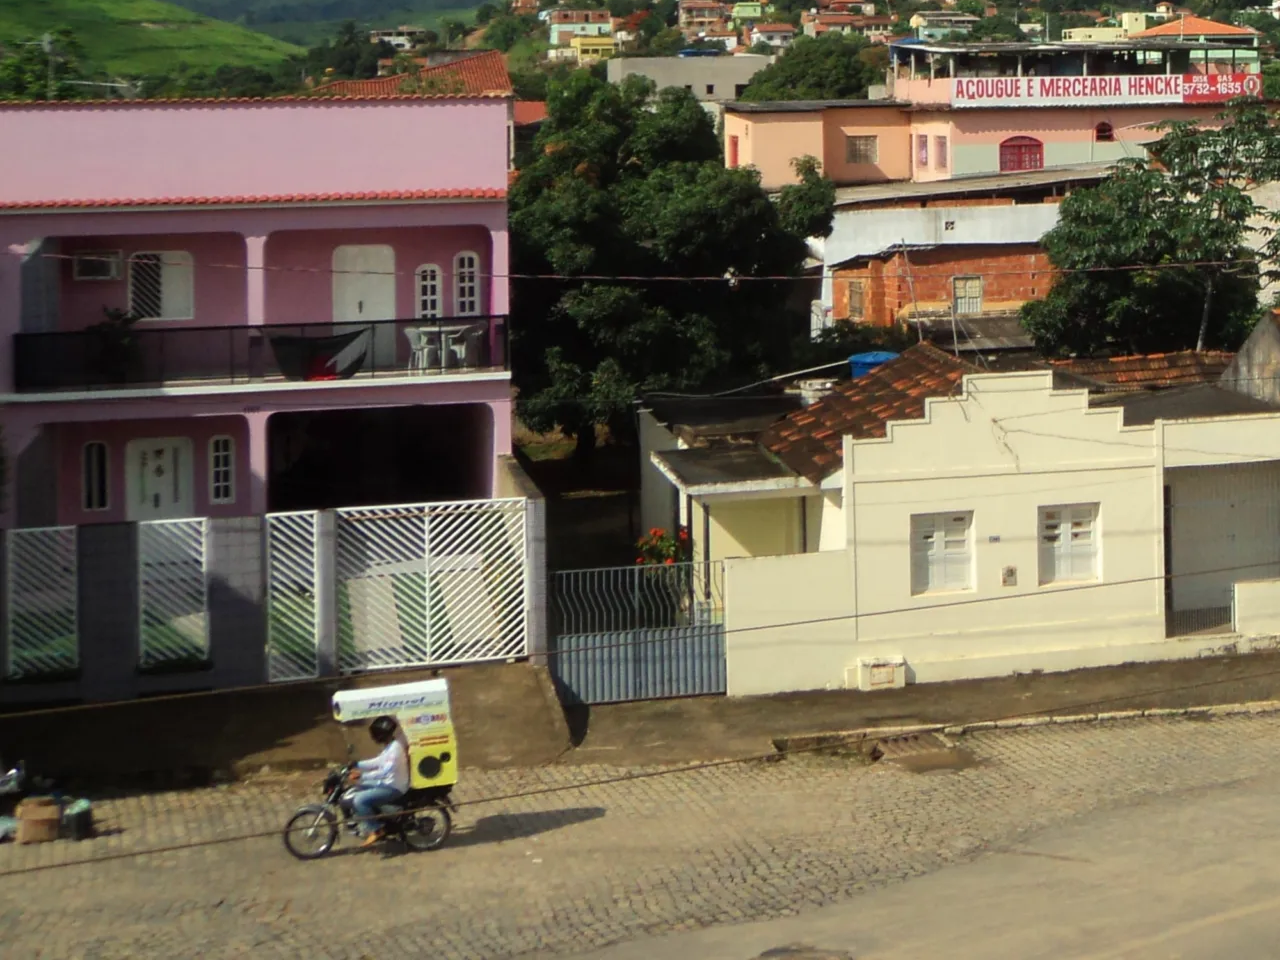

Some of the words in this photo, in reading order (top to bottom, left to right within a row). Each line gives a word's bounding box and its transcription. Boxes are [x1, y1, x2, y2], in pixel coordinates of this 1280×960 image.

[956, 79, 1021, 100] AÇOUGUE
[1027, 78, 1034, 97] E
[1040, 77, 1122, 97] MERCEARIA
[1128, 76, 1181, 96] HENCKE
[1183, 82, 1241, 95] 3732-1635
